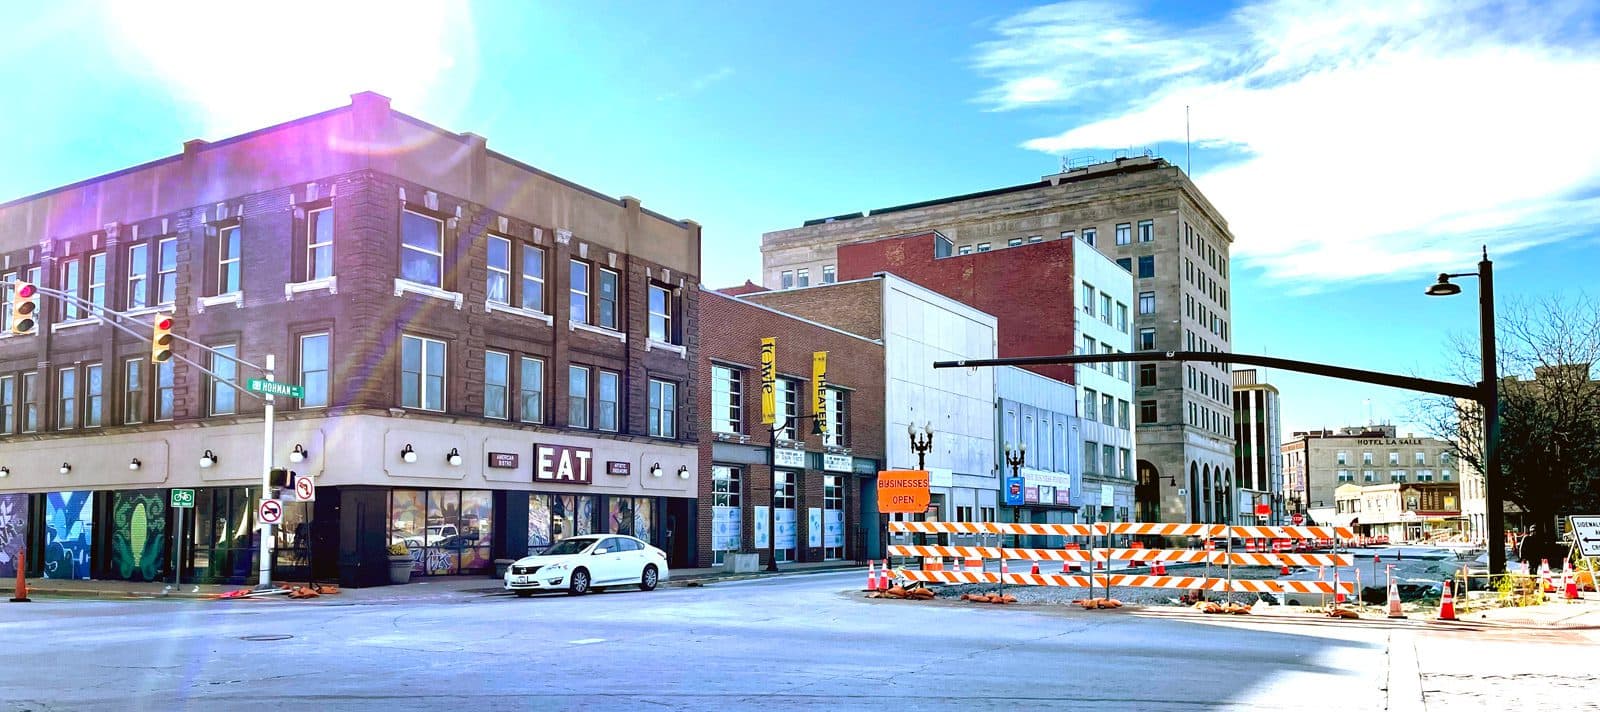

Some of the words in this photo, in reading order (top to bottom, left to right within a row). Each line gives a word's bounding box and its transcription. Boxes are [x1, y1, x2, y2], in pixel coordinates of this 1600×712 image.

[262, 381, 291, 396] HOHMAN
[818, 372, 827, 428] THEATER
[538, 446, 591, 481] EAT
[879, 479, 928, 488] BUSINESSES
[892, 495, 915, 504] OPEN
